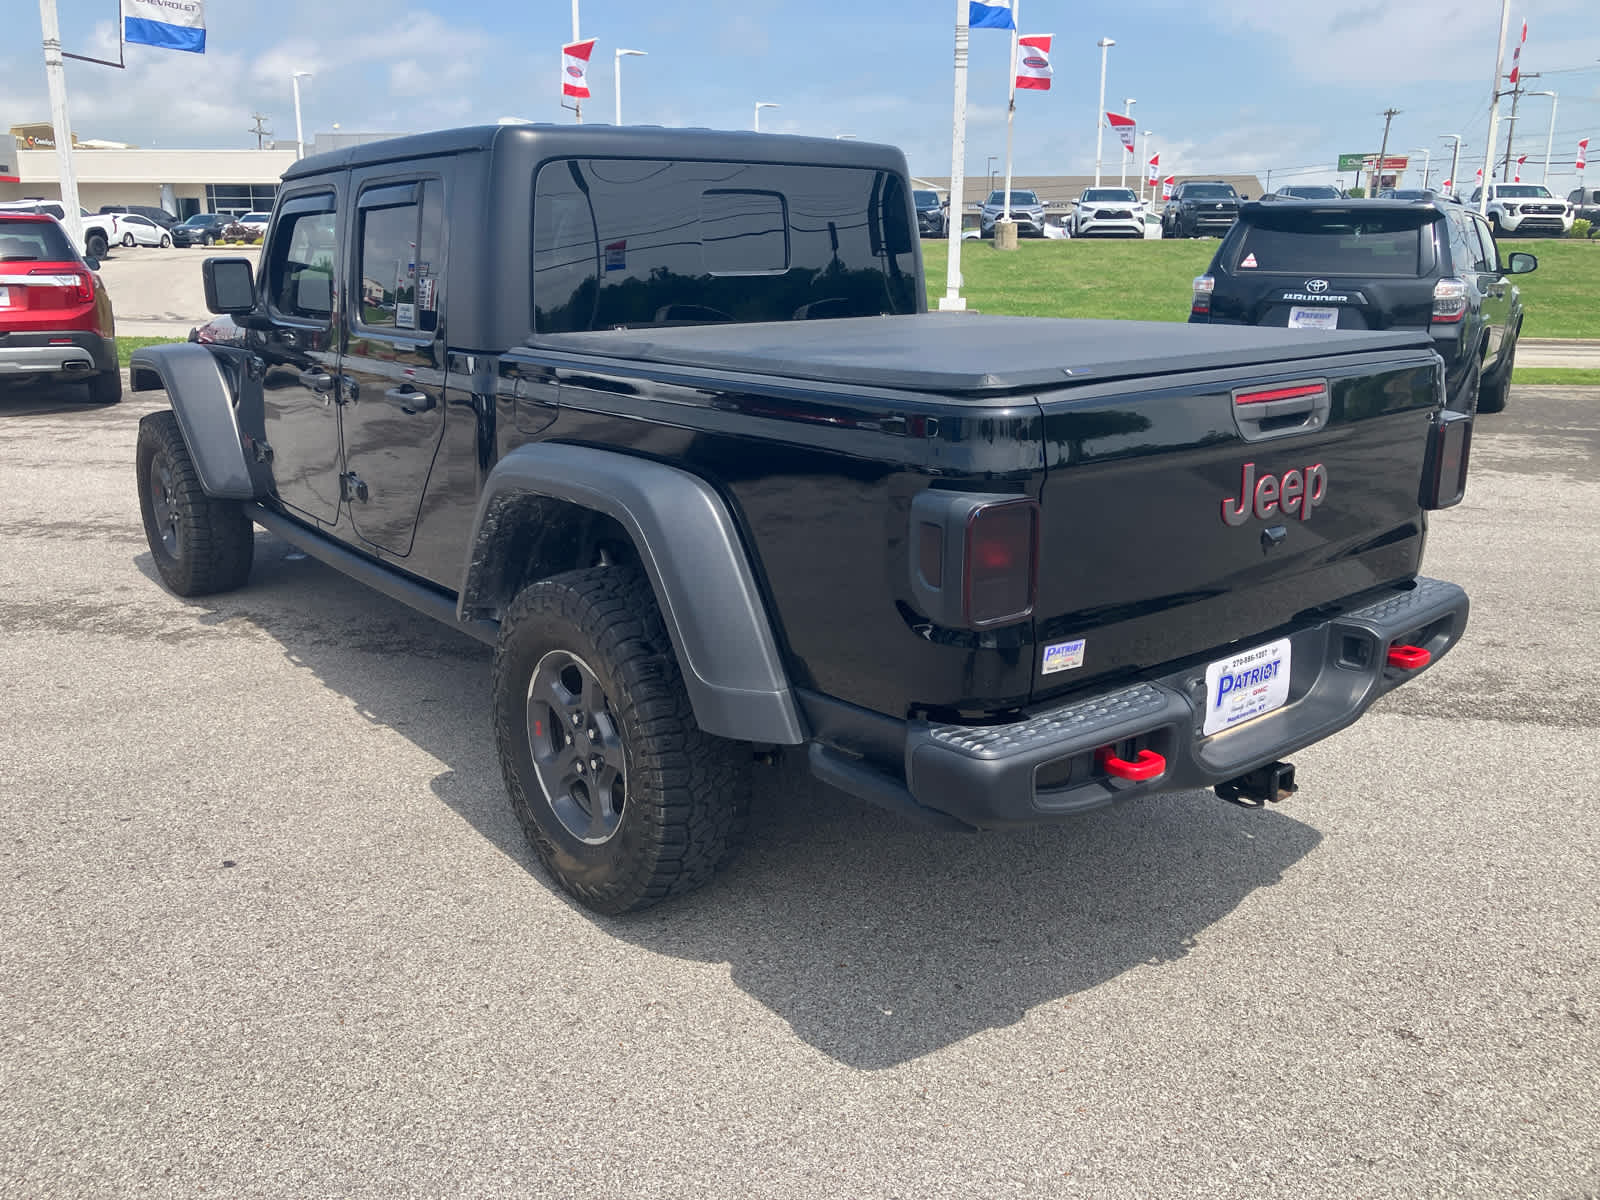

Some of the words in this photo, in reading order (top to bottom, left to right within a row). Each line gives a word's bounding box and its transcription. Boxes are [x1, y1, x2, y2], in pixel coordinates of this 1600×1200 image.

[1221, 462, 1328, 527] Jeep
[1046, 642, 1083, 662] PATRIOT
[1216, 659, 1281, 708] PATRIOT
